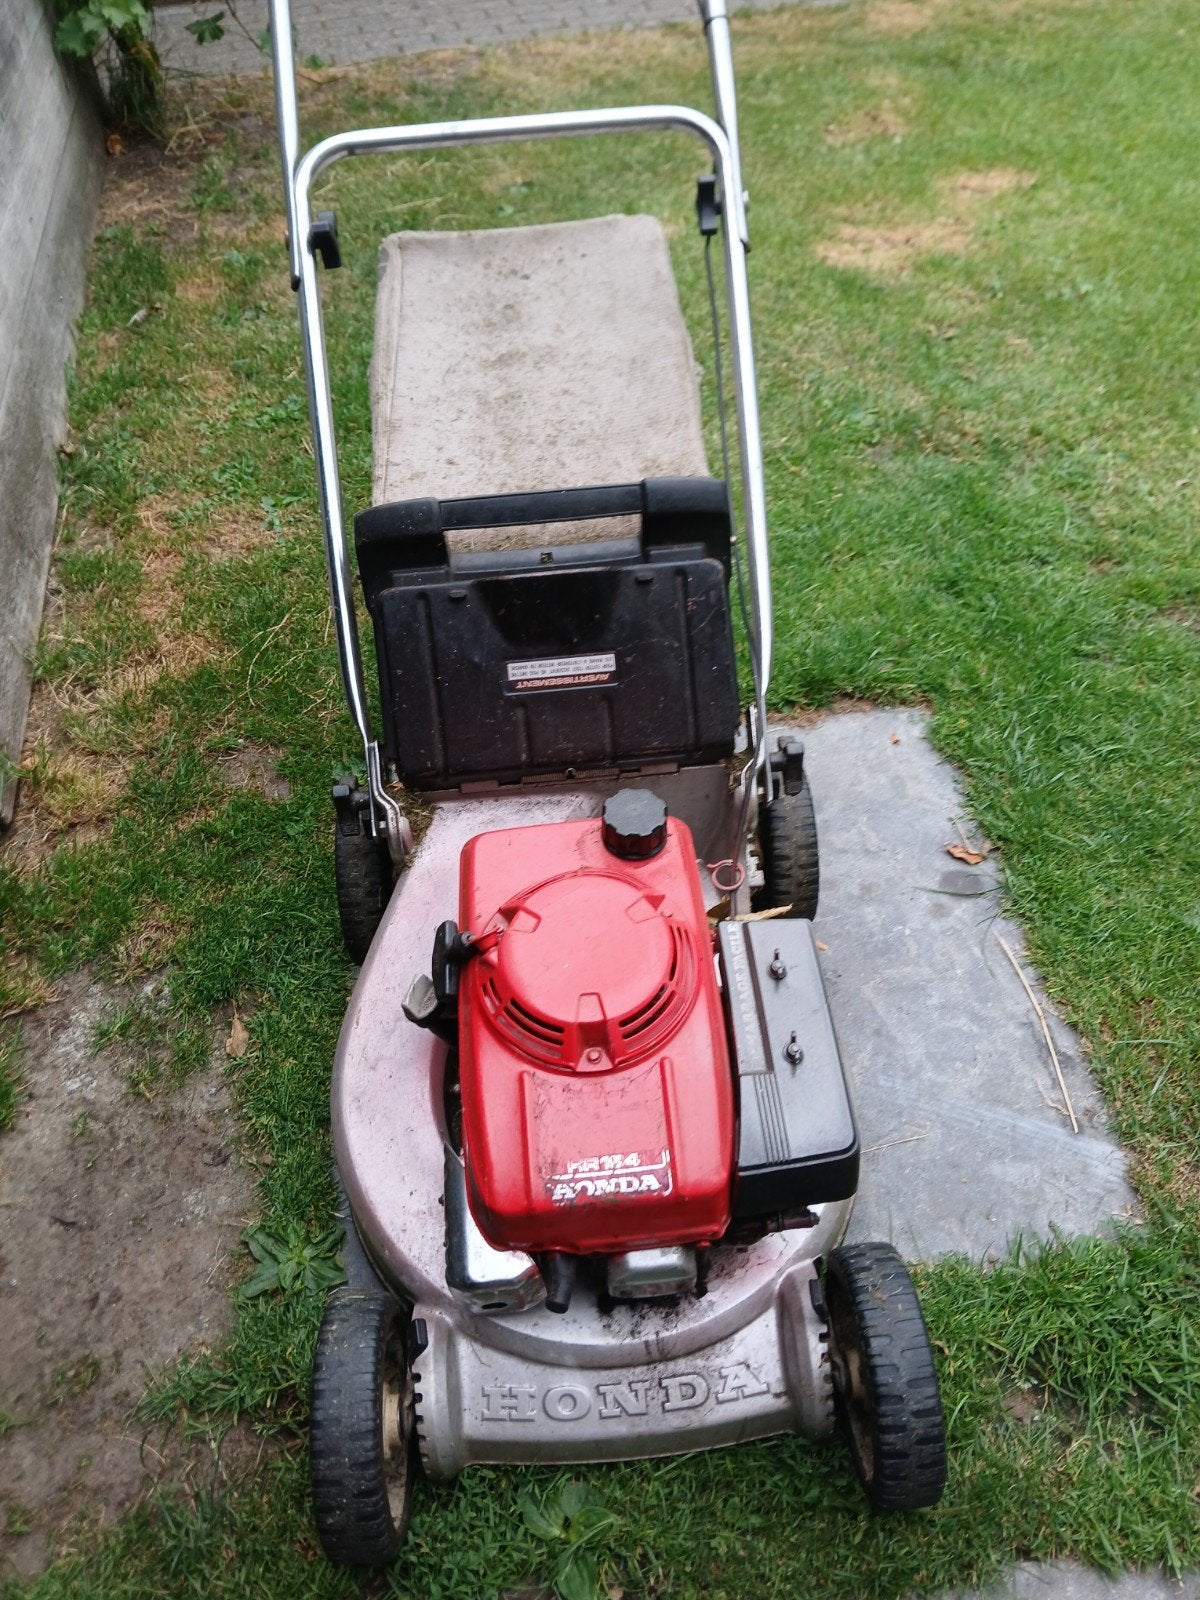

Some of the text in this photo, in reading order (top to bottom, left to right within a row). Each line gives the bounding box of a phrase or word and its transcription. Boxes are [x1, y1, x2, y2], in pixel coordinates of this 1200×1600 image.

[515, 673, 610, 689] AVERTISSEMENT
[552, 1174, 662, 1200] HONDA
[481, 1362, 771, 1421] HONDA
